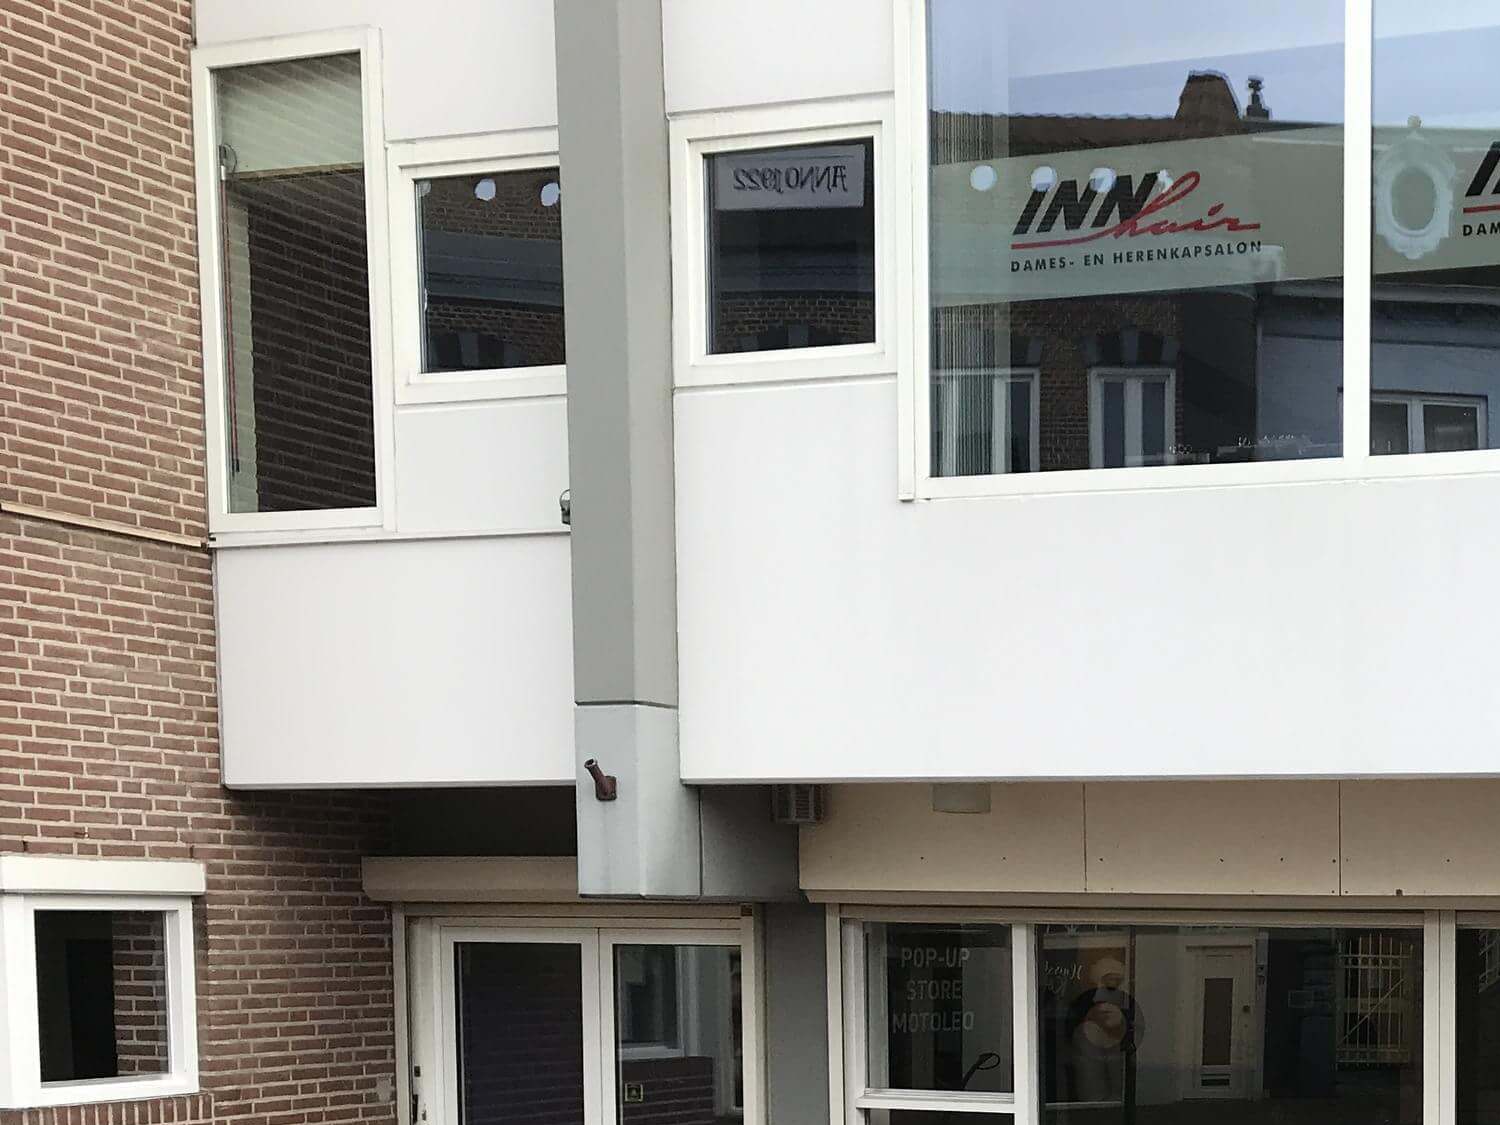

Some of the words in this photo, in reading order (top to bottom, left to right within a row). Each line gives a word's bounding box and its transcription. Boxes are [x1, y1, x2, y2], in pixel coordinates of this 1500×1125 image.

[1013, 172, 1160, 235] INN
[1011, 256, 1075, 273] DAMES-
[1084, 253, 1104, 267] EN
[1113, 240, 1262, 264] HERENKAPSALON
[901, 946, 970, 969] POP-UP
[906, 979, 962, 1001] STORE
[892, 1010, 975, 1033] MOTOLEO
